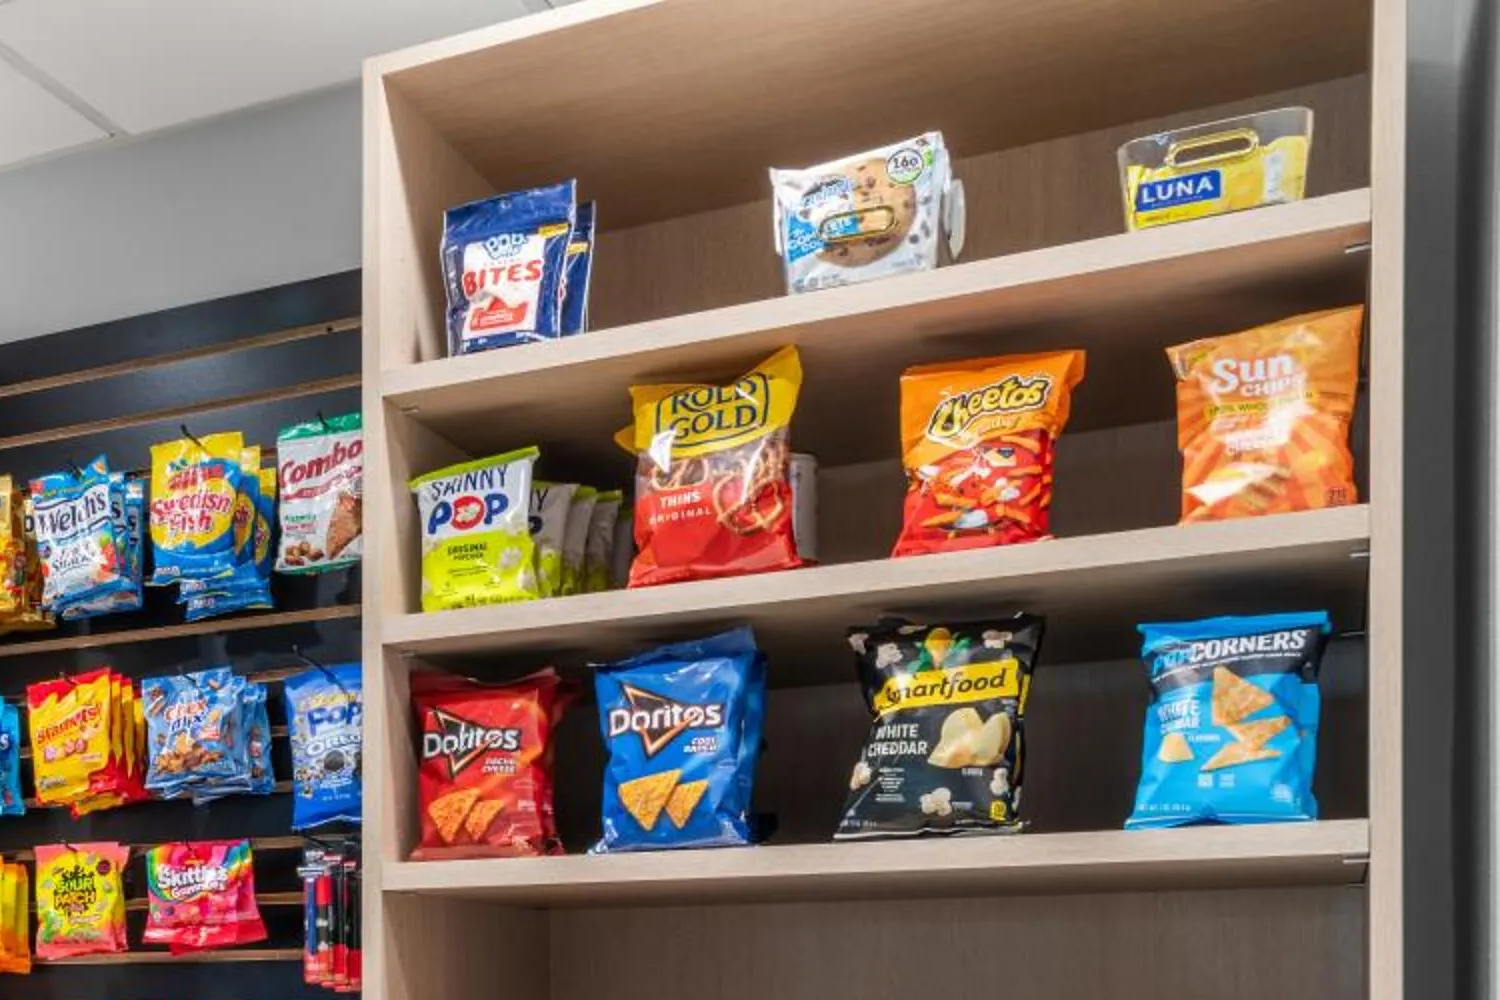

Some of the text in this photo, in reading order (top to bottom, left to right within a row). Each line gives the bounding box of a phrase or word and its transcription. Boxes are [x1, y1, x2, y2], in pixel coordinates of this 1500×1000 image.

[892, 157, 919, 170] 160
[1141, 174, 1215, 204] LUNA
[485, 233, 525, 251] POP
[462, 258, 543, 298] BITES
[1211, 352, 1297, 394] Sun
[669, 376, 758, 414] ROLD
[927, 377, 1051, 438] Cheetos
[668, 405, 758, 440] GOLD
[279, 438, 363, 488] Combo
[431, 463, 509, 501] SKINNY
[659, 490, 703, 508] THINS
[37, 490, 106, 535] Welch's
[150, 486, 232, 520] Swedish
[427, 492, 509, 535] POP
[648, 507, 713, 526] ORIGINAL
[167, 508, 214, 533] Fish
[446, 541, 488, 556] ORIGINAL
[609, 703, 722, 738] Doritos
[875, 723, 920, 739] WHITE
[423, 721, 520, 759] Doritos
[867, 740, 928, 758] CHEDDAR
[156, 864, 229, 889] Skittles
